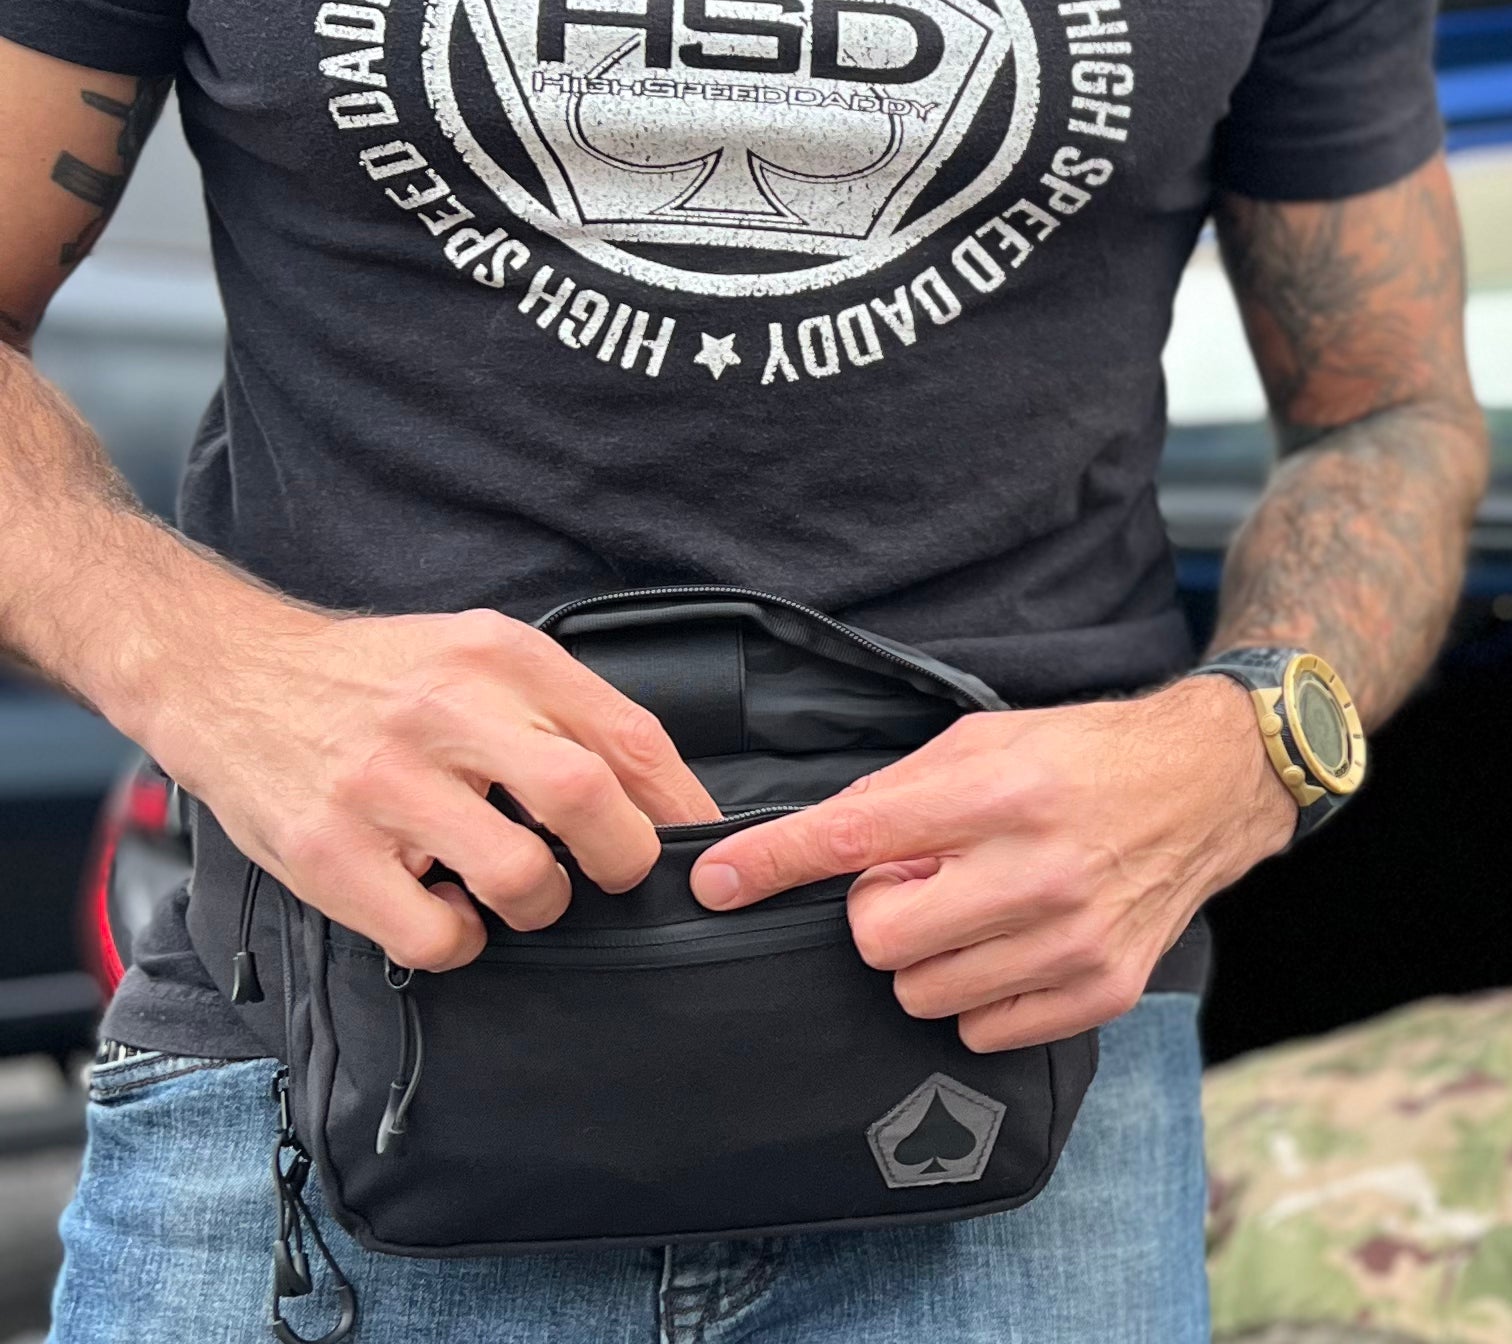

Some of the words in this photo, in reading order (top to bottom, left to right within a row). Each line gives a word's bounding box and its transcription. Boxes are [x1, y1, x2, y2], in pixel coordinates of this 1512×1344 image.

[359, 141, 530, 287] SPEED
[952, 147, 1113, 293] SPEED
[518, 265, 676, 376] HIGH
[761, 266, 961, 384] DADDY
